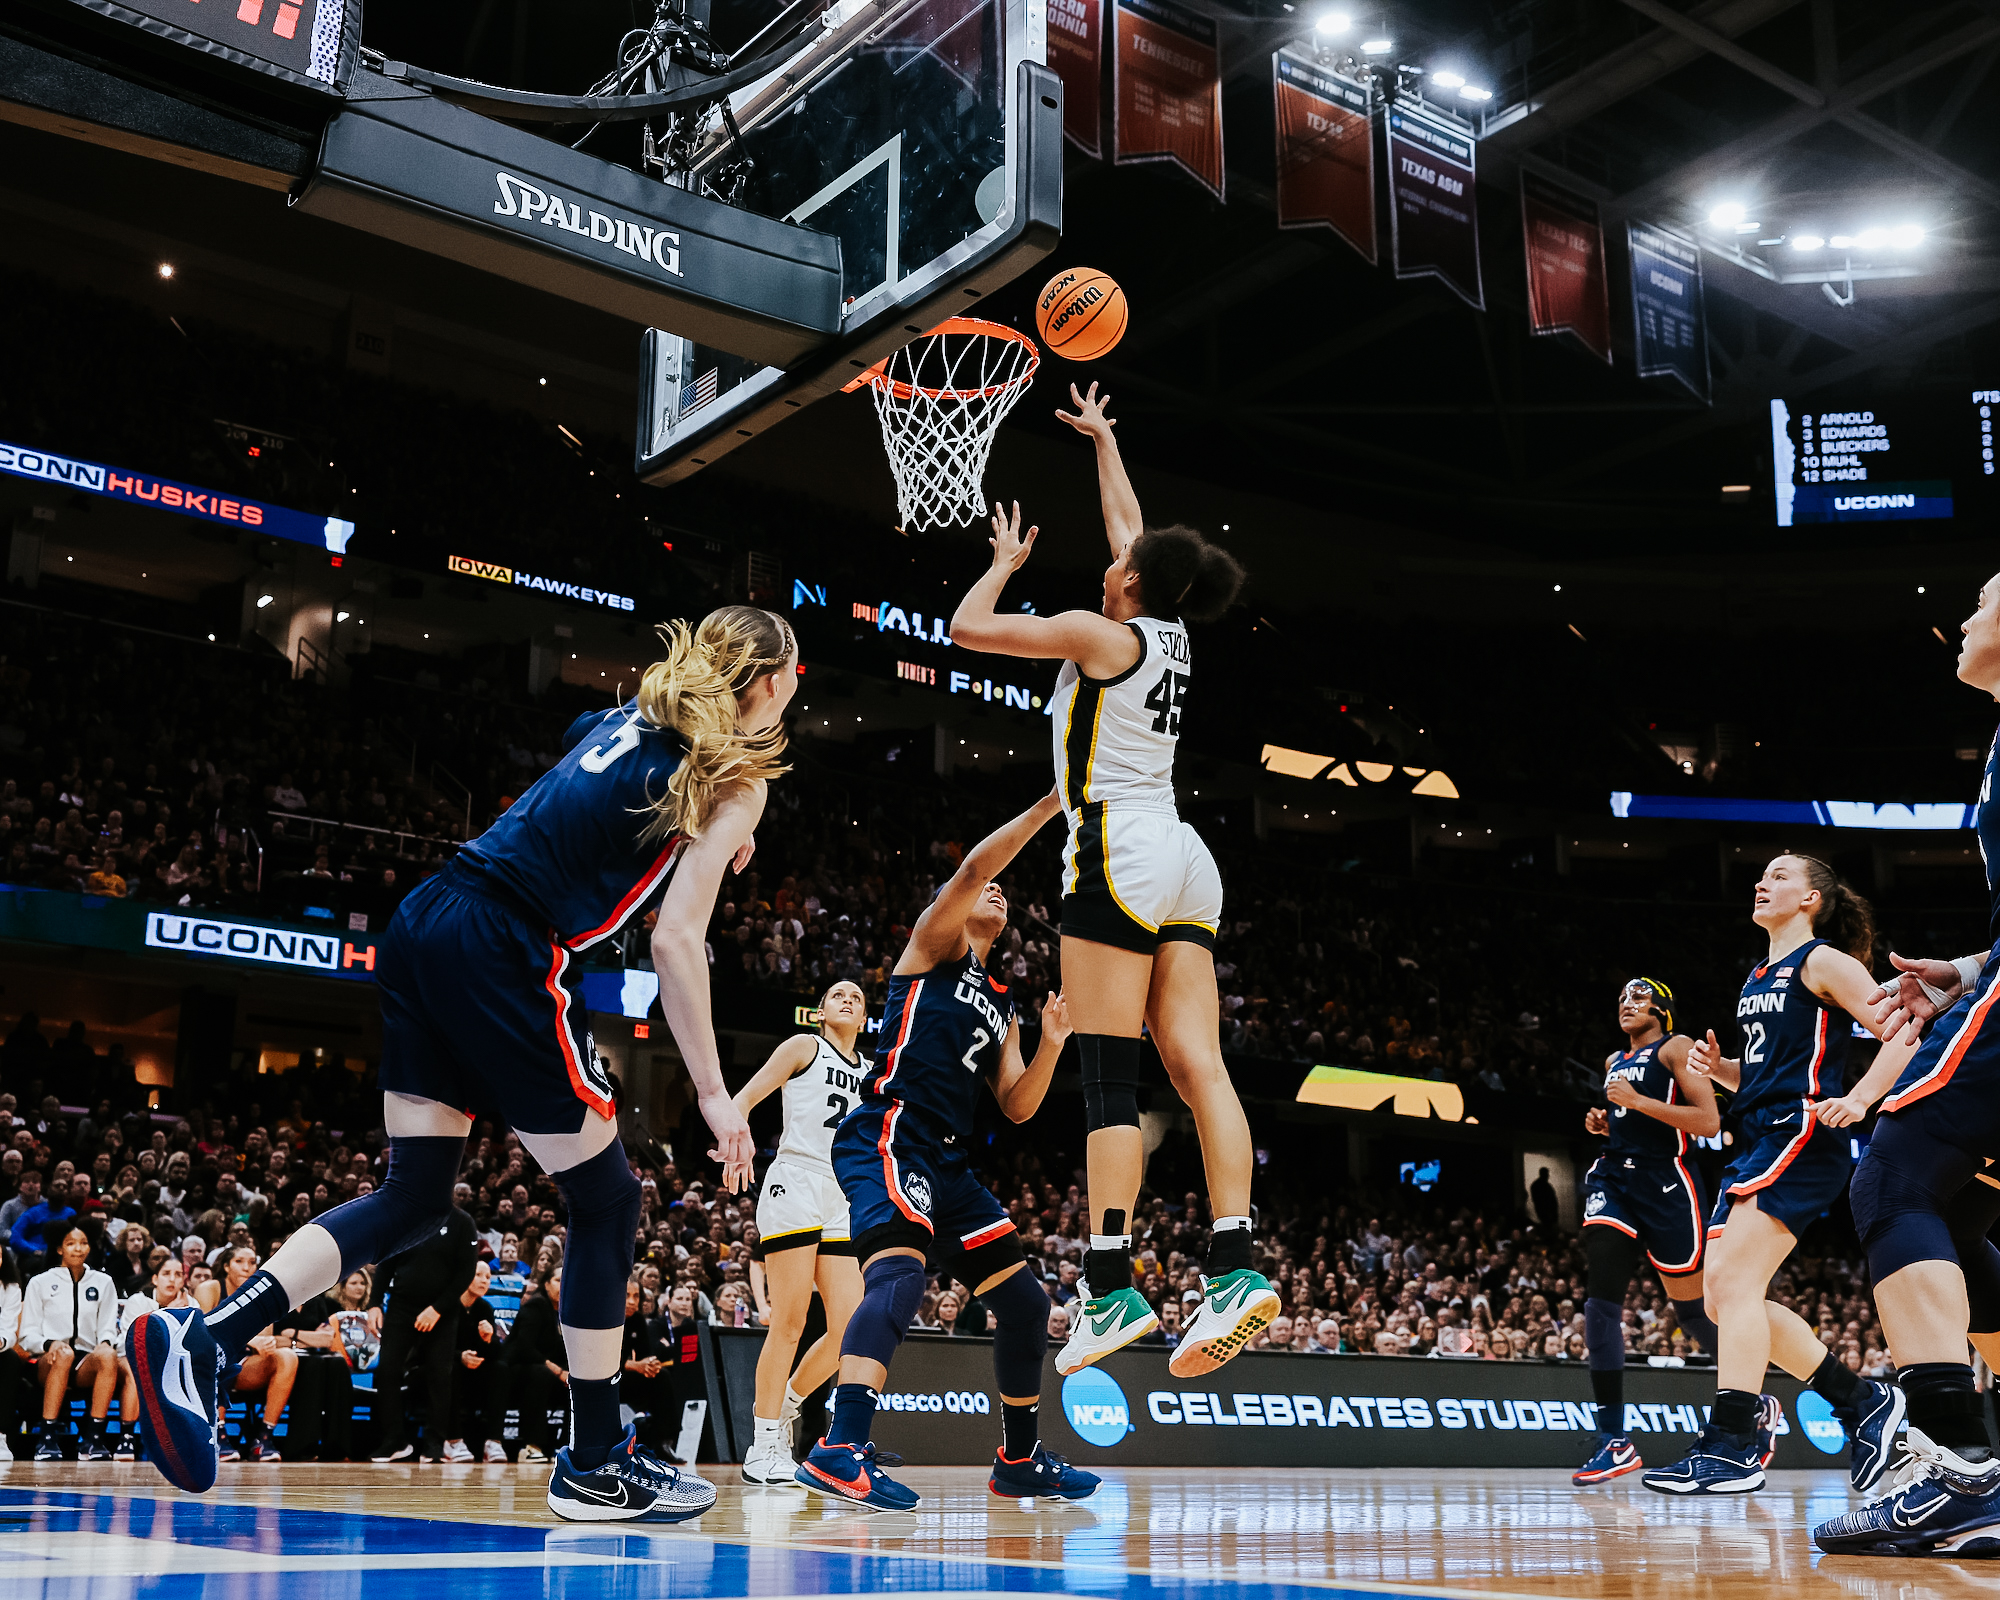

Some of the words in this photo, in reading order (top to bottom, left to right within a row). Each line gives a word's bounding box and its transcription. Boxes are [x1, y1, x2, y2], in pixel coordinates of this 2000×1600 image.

[1401, 157, 1436, 184] TEXAS
[493, 171, 681, 277] SPALDING
[1041, 273, 1077, 311] NCAA
[1051, 286, 1105, 332] Wilson
[1819, 411, 1874, 426] ARNOLD
[1820, 425, 1887, 440] EDWARDS
[1801, 456, 1820, 469] 10
[1821, 438, 1890, 454] BUECKERS
[1802, 470, 1820, 483] 12
[1822, 467, 1868, 482] SHADE
[108, 473, 263, 525] HUSKIES
[1834, 494, 1915, 511] UCONN
[452, 557, 509, 581] IOWA
[514, 571, 635, 612] HAWKEYES
[1144, 668, 1190, 736] 45
[156, 917, 334, 965] UCONN
[962, 1027, 990, 1074] 2
[1743, 1021, 1766, 1065] 12
[944, 1390, 991, 1415] QQQ
[1072, 1404, 1130, 1426] NCAA
[1147, 1391, 1434, 1429] CELEBRATES
